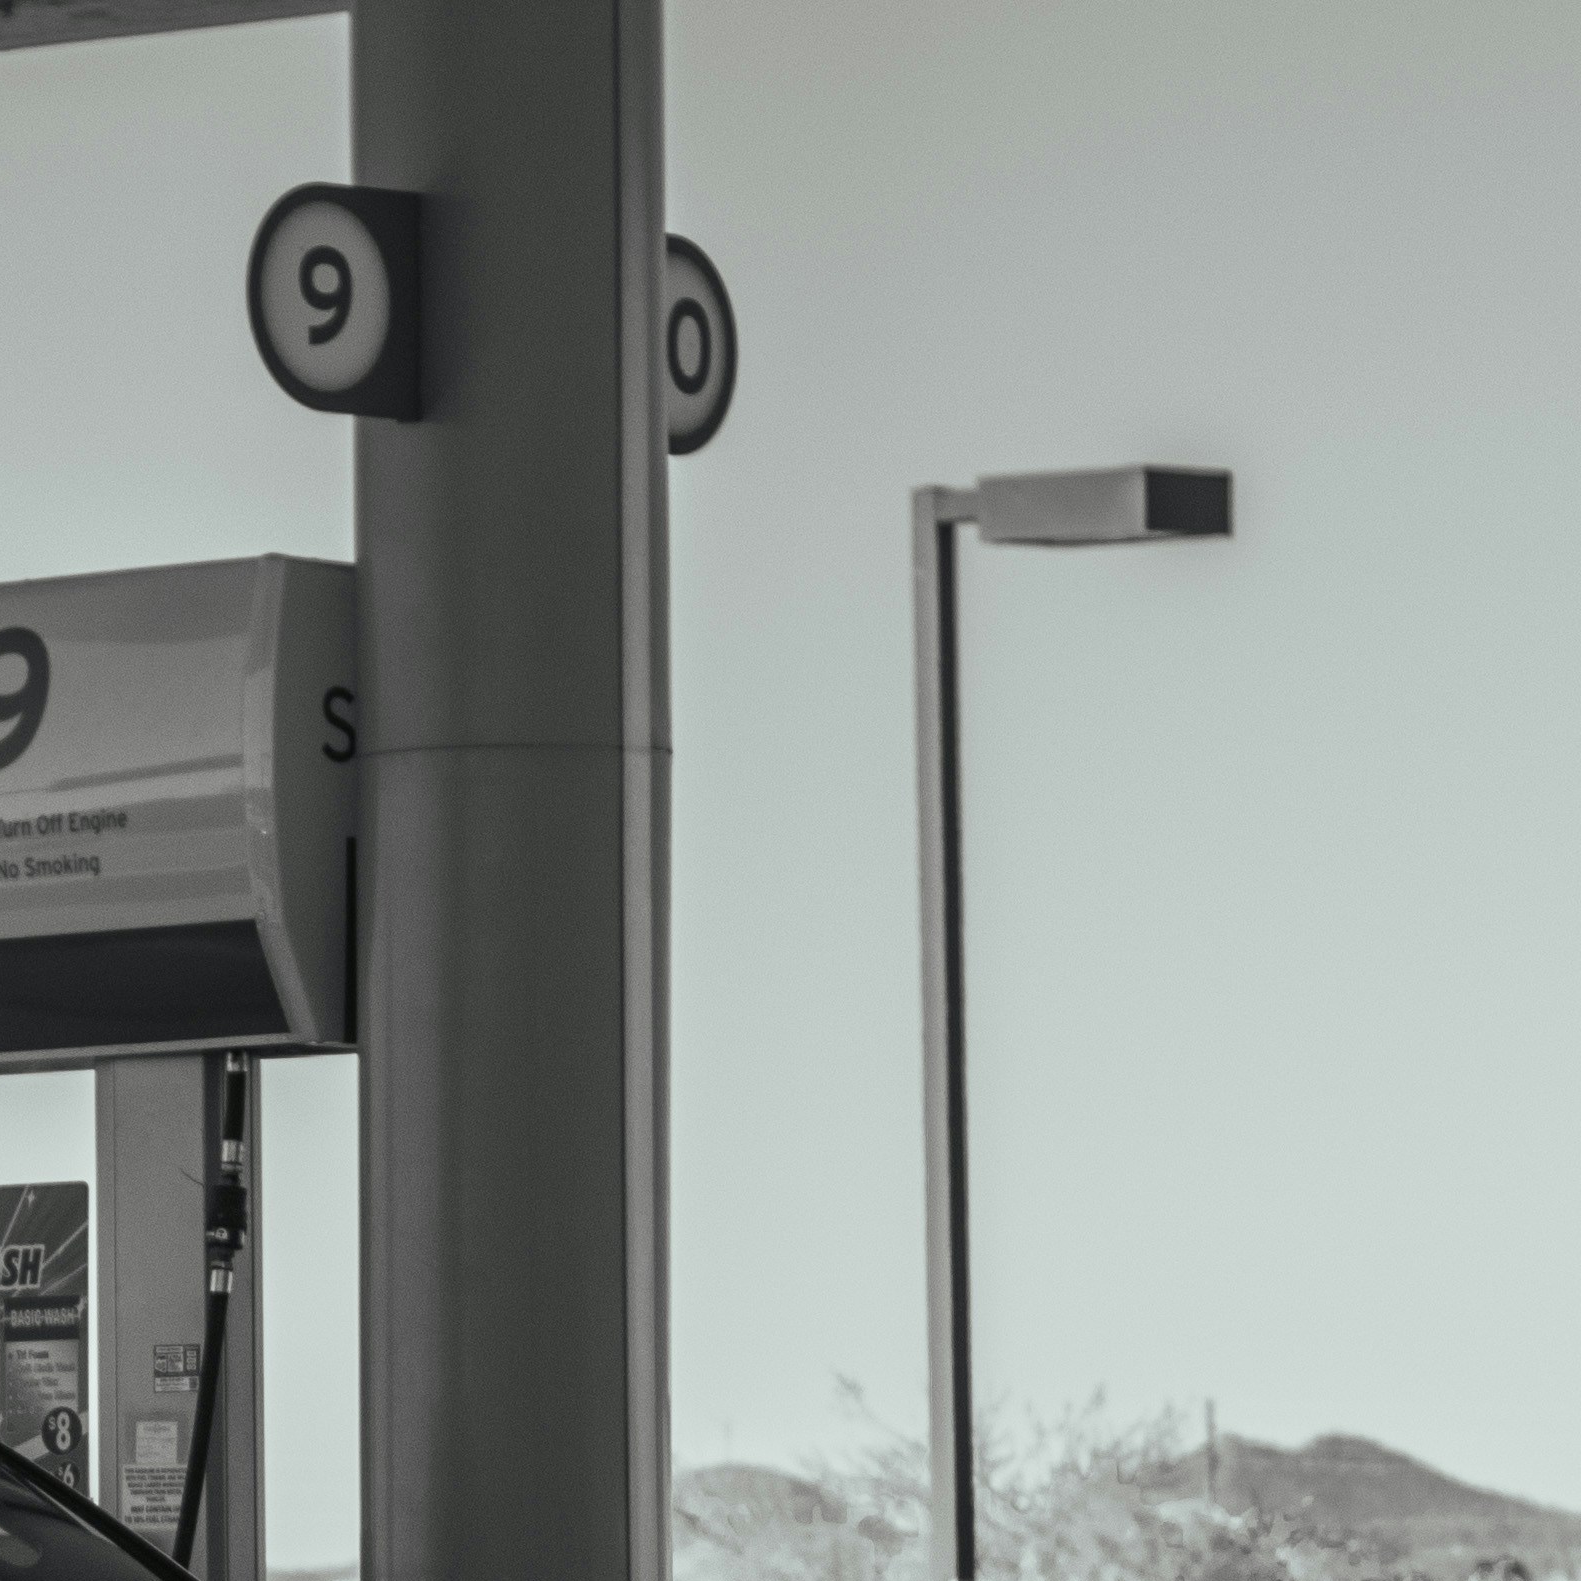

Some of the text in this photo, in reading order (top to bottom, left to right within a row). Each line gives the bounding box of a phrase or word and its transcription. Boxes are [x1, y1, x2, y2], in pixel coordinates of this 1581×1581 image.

[298, 244, 354, 347] 9
[37, 813, 62, 836] Off
[68, 809, 127, 837] Engine
[24, 853, 100, 878] Smoking
[11, 1307, 76, 1327] BASIC WASH
